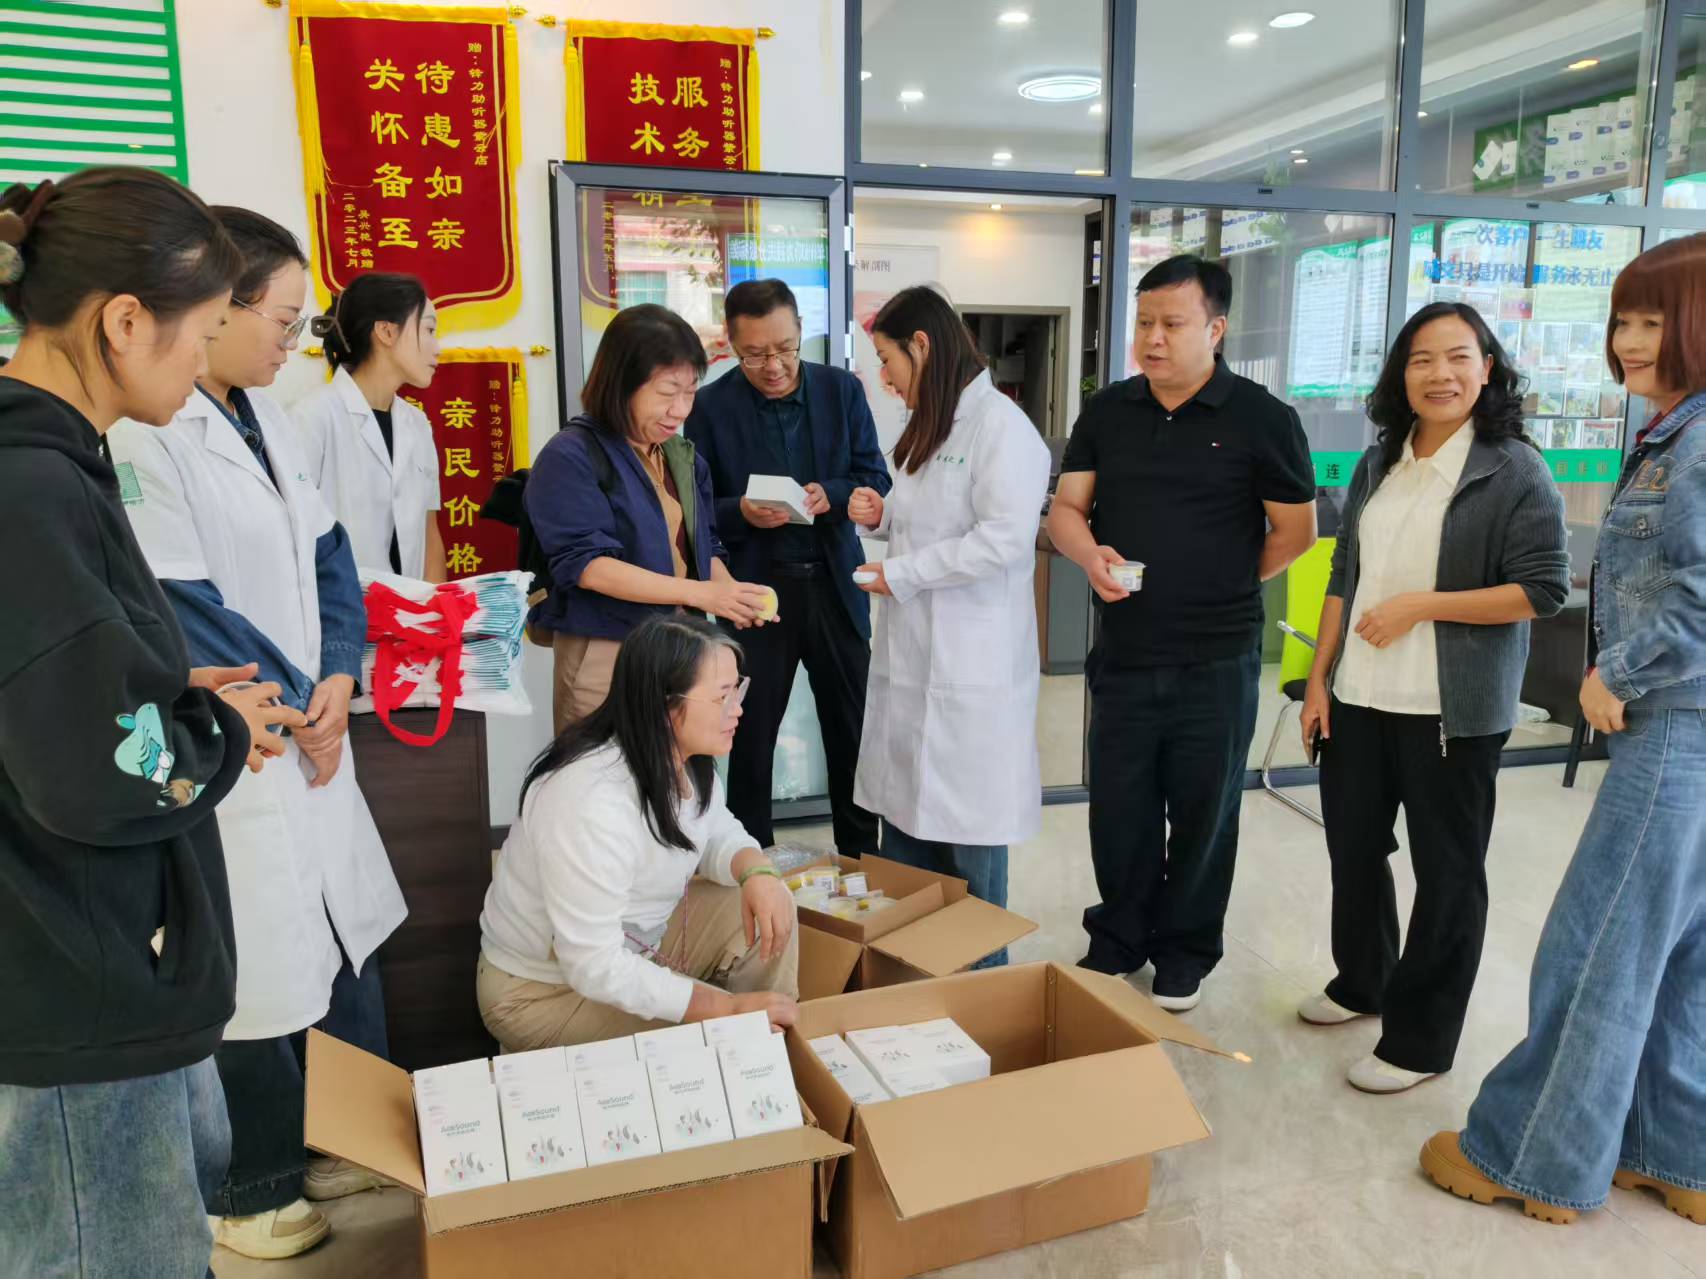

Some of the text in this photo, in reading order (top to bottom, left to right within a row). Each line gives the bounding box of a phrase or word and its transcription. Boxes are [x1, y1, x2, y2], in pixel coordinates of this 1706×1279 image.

[364, 58, 419, 249] 关怀备至
[414, 60, 465, 250] 待患如亲
[1532, 263, 1622, 288] 服务永无止
[440, 397, 483, 574] 亲民价格
[1326, 463, 1340, 480] 连
